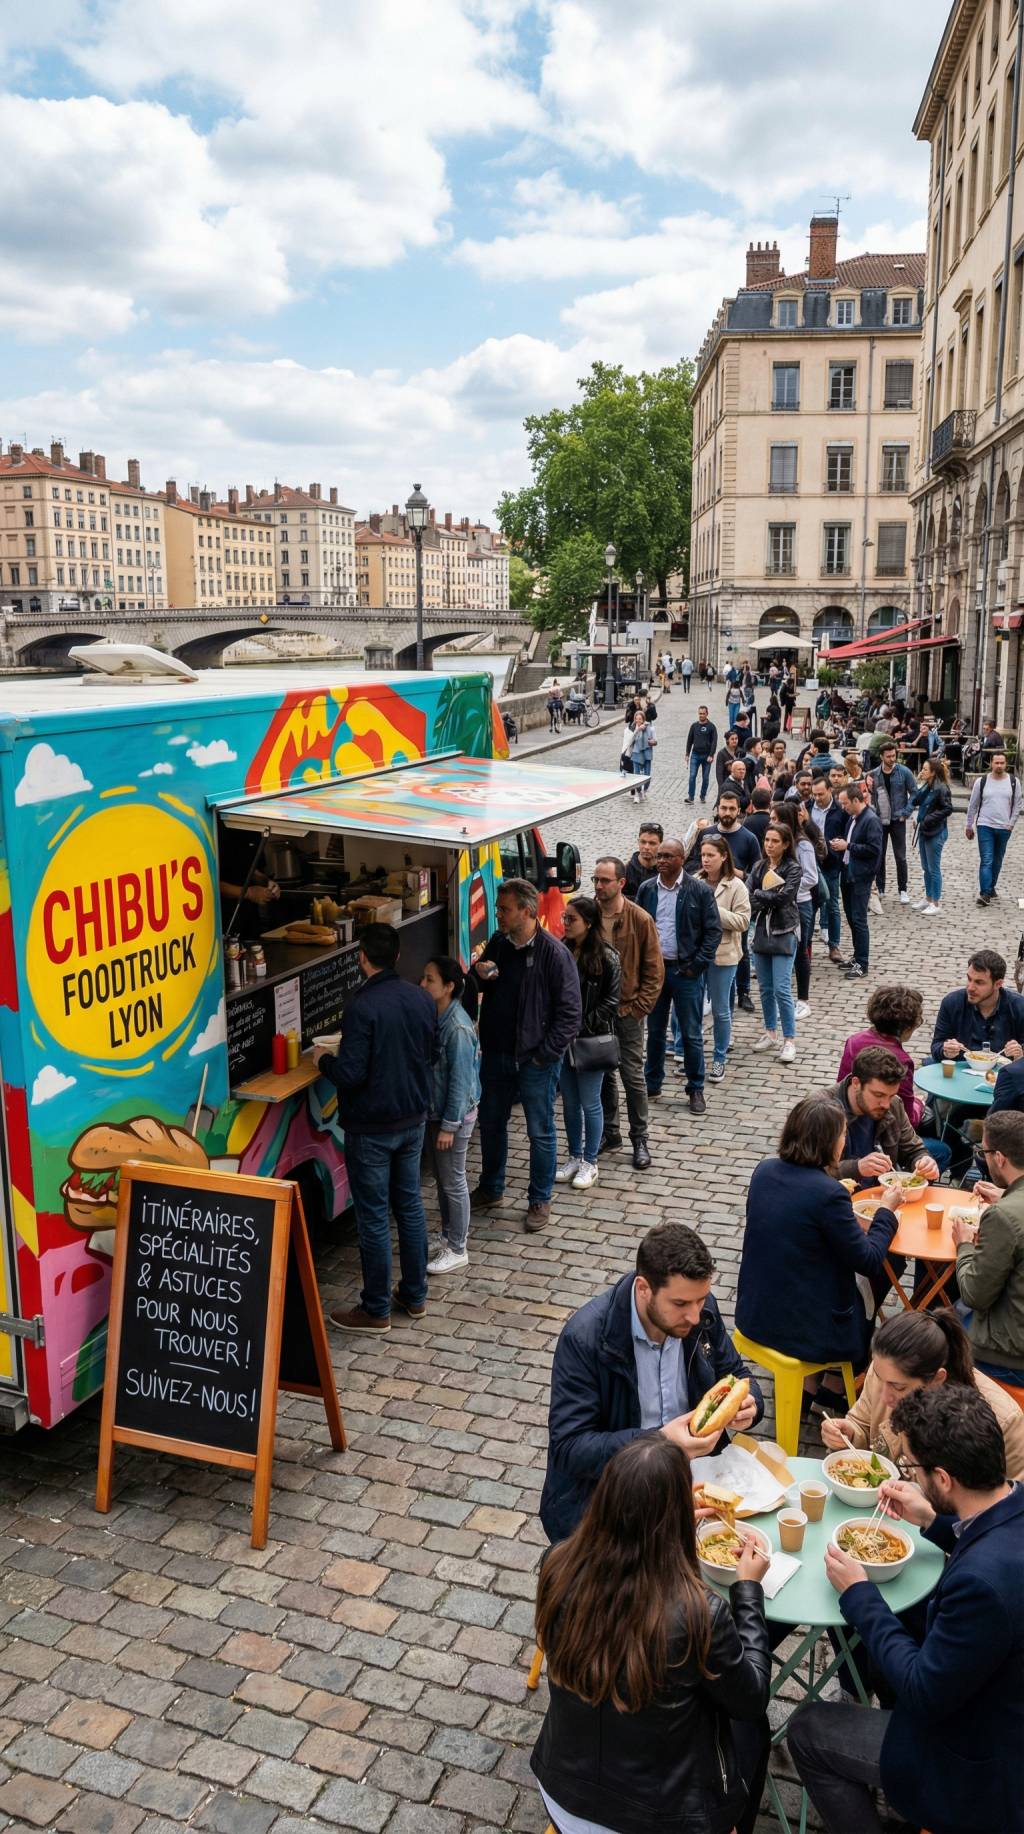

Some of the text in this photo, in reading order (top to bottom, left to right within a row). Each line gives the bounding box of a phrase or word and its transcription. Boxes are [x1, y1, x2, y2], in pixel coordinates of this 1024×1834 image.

[43, 856, 203, 965] CHIBU'S
[62, 933, 197, 1016] FOODTRUCK
[109, 993, 163, 1048] LYON
[137, 1262, 241, 1303] & ASTUCES
[136, 1296, 239, 1335] POUR NOUS
